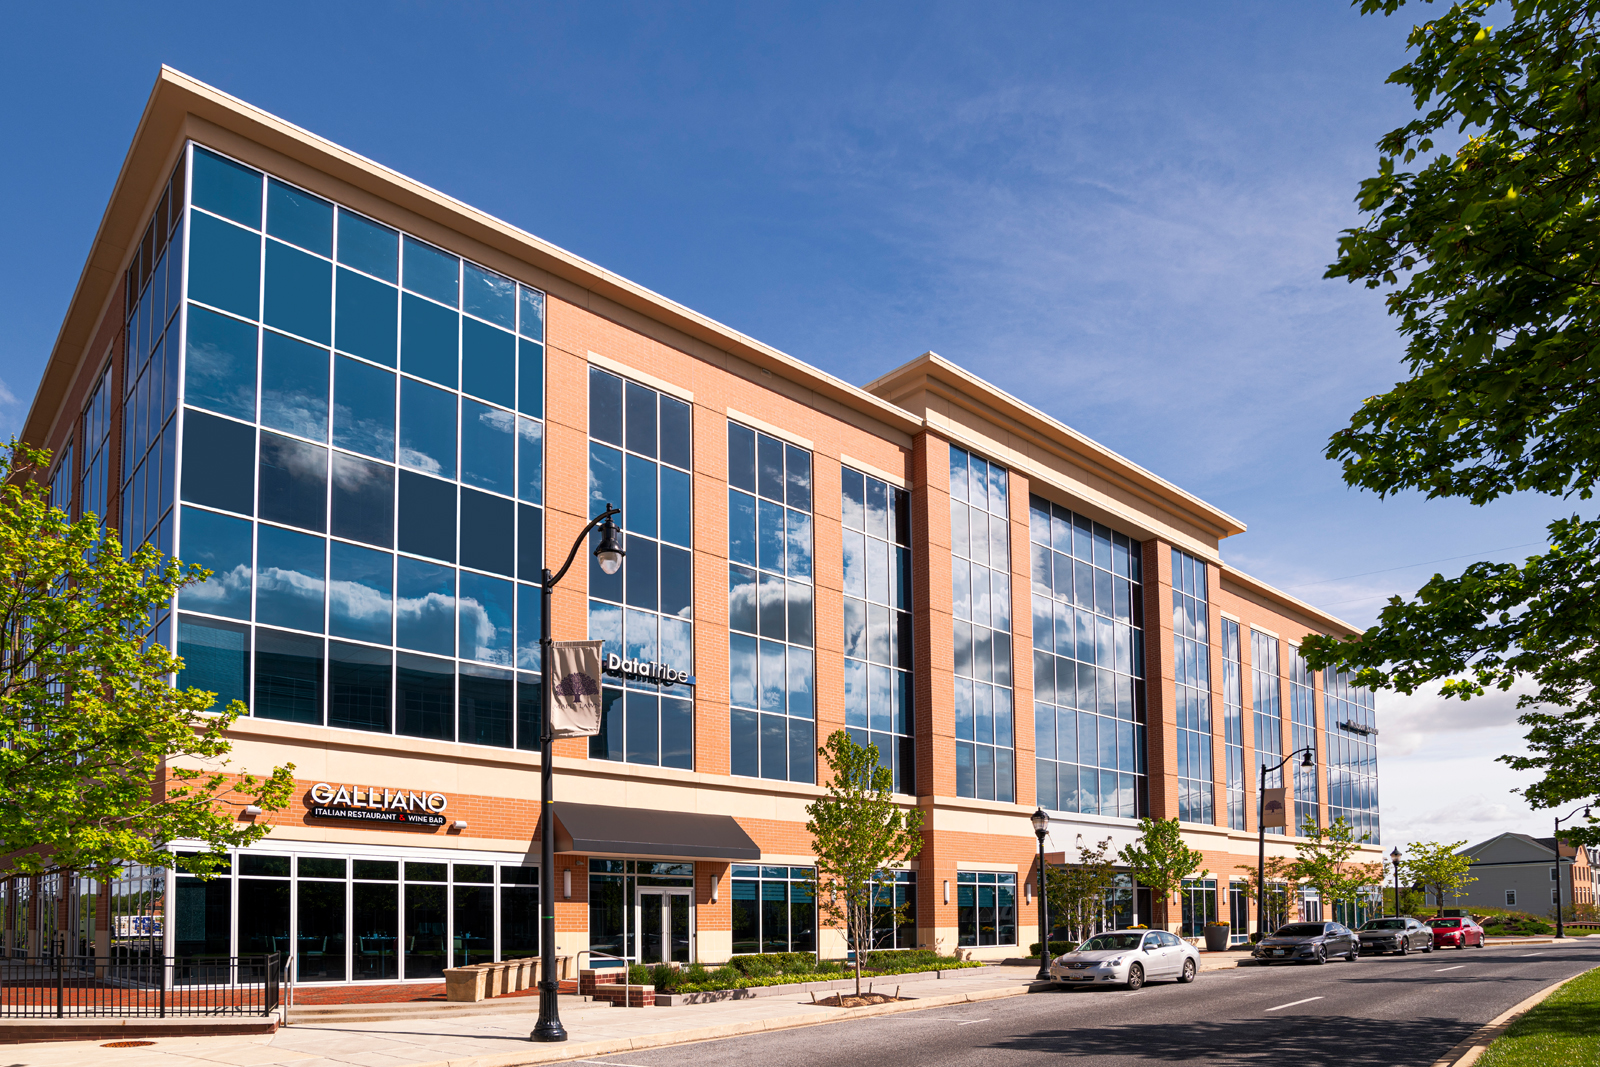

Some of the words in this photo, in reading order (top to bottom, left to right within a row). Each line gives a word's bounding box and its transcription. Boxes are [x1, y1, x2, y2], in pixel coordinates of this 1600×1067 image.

[607, 653, 688, 683] DataTribe
[311, 783, 448, 812] GALLIANO
[315, 808, 347, 817] ITALIAN
[347, 811, 397, 821] RESTAURANT
[399, 814, 406, 822] &
[408, 815, 428, 823] WINE
